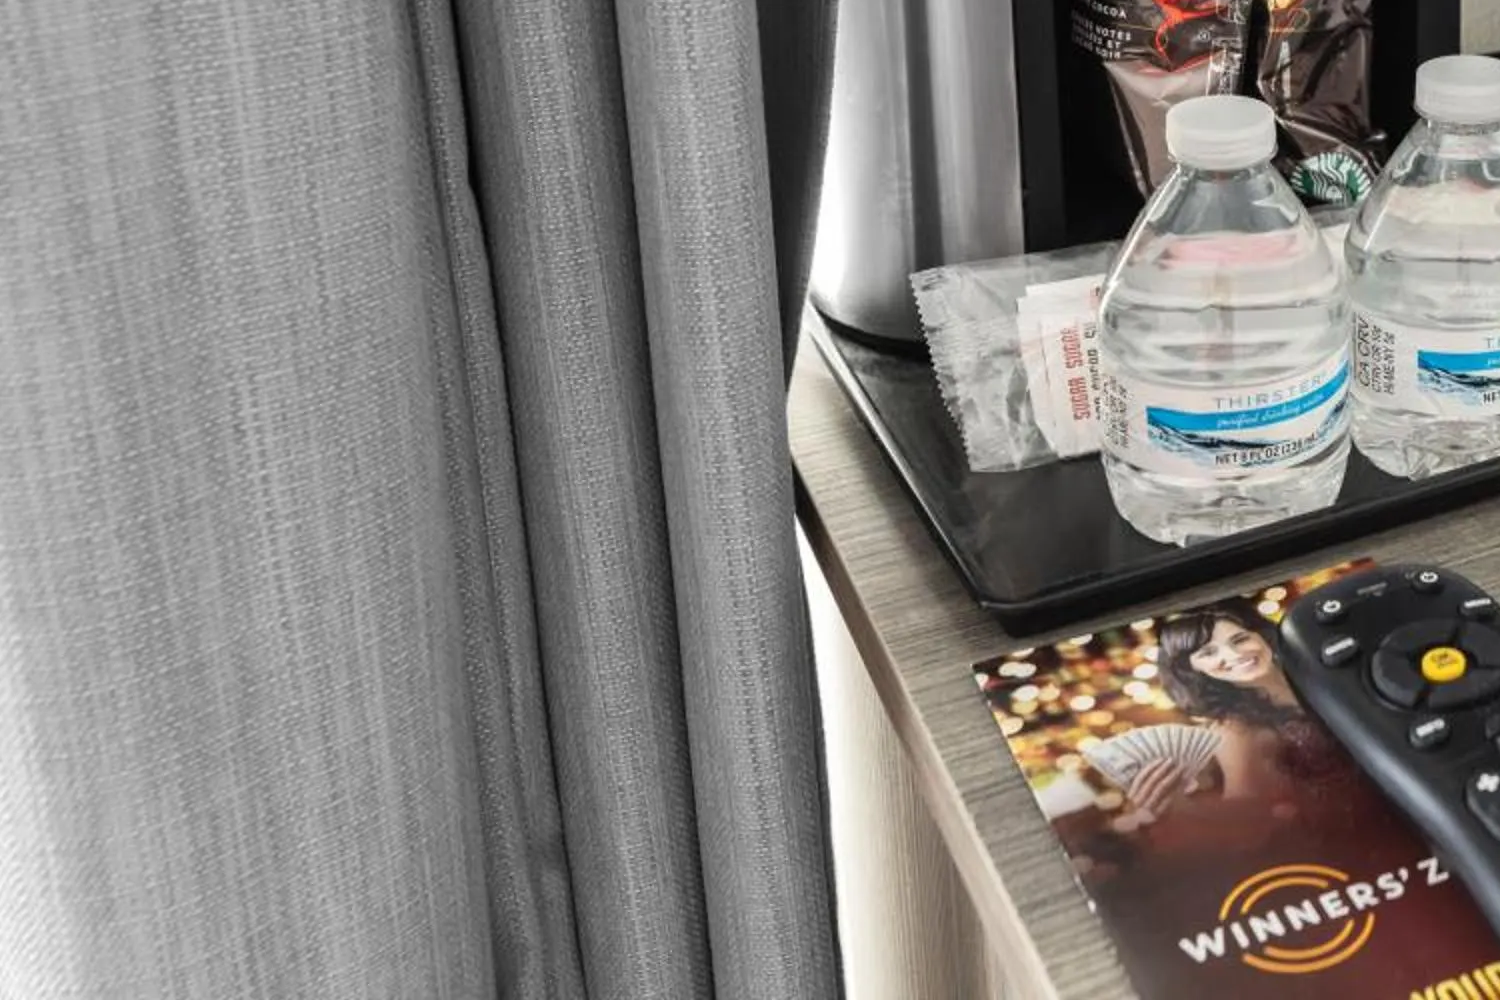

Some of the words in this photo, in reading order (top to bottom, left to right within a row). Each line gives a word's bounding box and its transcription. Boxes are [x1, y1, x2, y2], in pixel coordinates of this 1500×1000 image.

[1356, 315, 1371, 357] CRV
[1068, 376, 1092, 421] SUGAR
[1178, 867, 1410, 964] WINNERS'
